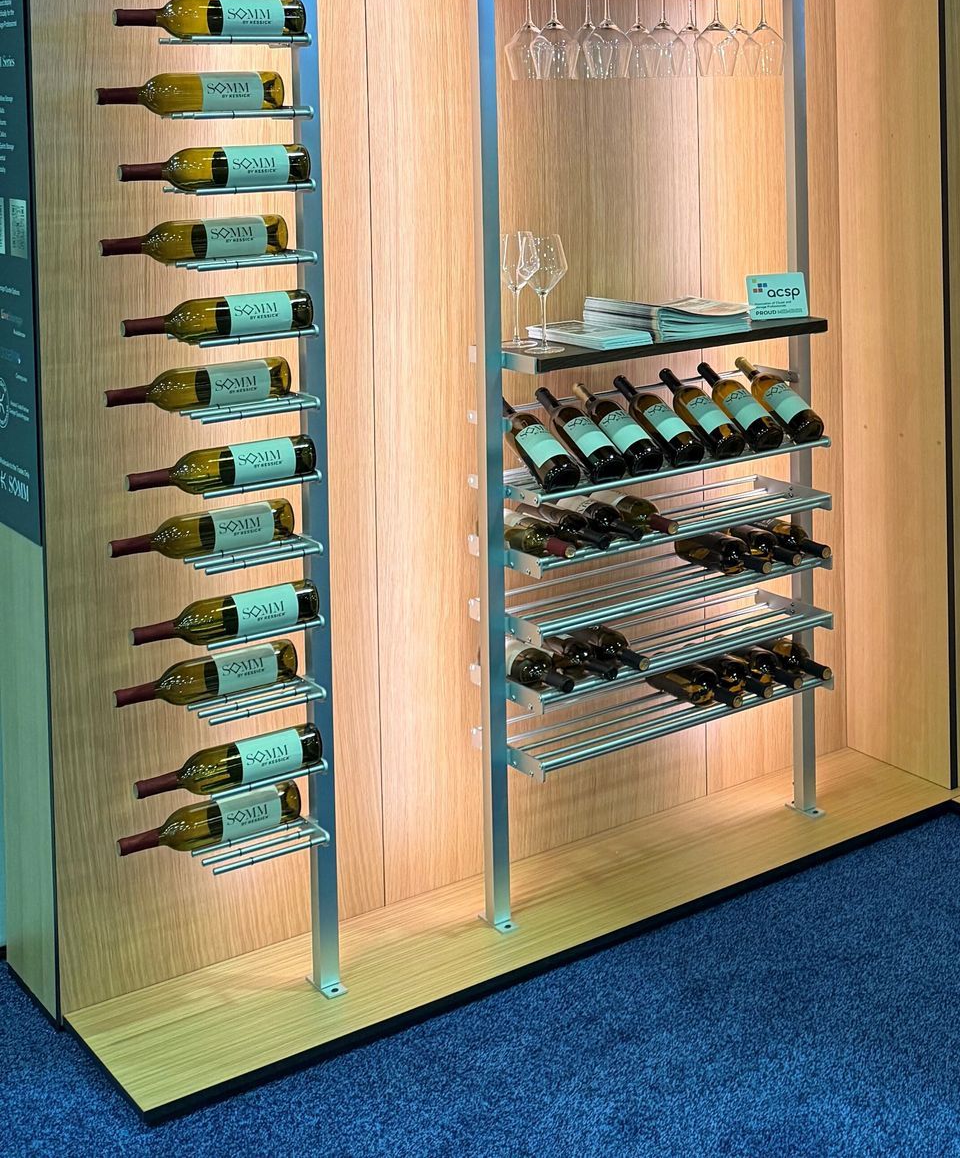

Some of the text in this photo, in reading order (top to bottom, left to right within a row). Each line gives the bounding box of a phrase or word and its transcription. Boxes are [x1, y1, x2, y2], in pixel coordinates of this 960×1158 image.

[767, 287, 800, 300] acsp
[265, 612, 286, 620] KESSICK
[244, 668, 264, 676] KESSICK
[268, 756, 289, 765] KESSICK
